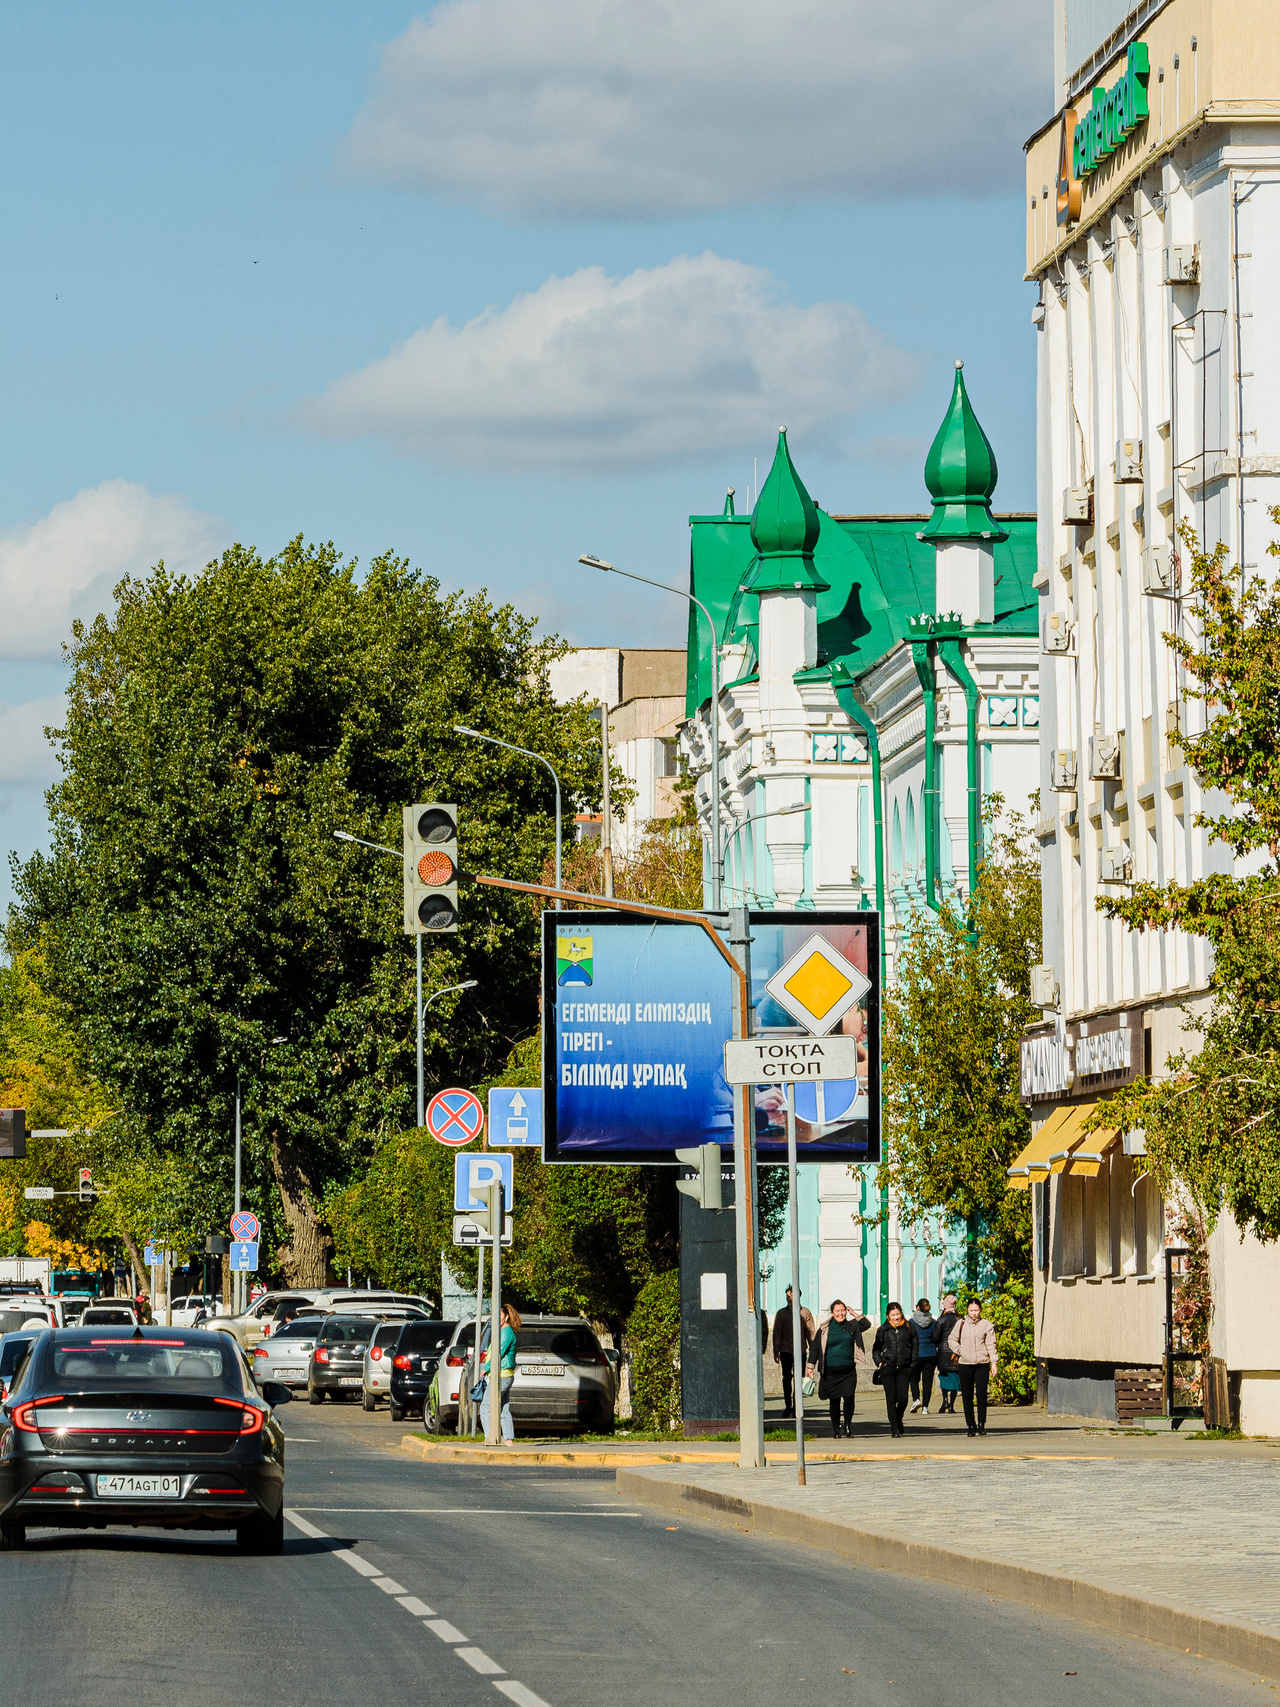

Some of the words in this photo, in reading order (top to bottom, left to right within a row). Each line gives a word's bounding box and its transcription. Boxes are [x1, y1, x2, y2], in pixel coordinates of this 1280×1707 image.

[562, 1003, 631, 1025] ЕГЕМЕНДІ
[635, 1003, 712, 1026] ЕЛІМІЗДІҢ
[562, 1033, 604, 1052] ТІРЕГІ
[755, 1044, 826, 1059] ТОҚТА
[561, 1063, 629, 1090] БІЛІМДІ
[762, 1063, 822, 1077] СТОП
[469, 1159, 502, 1206] P
